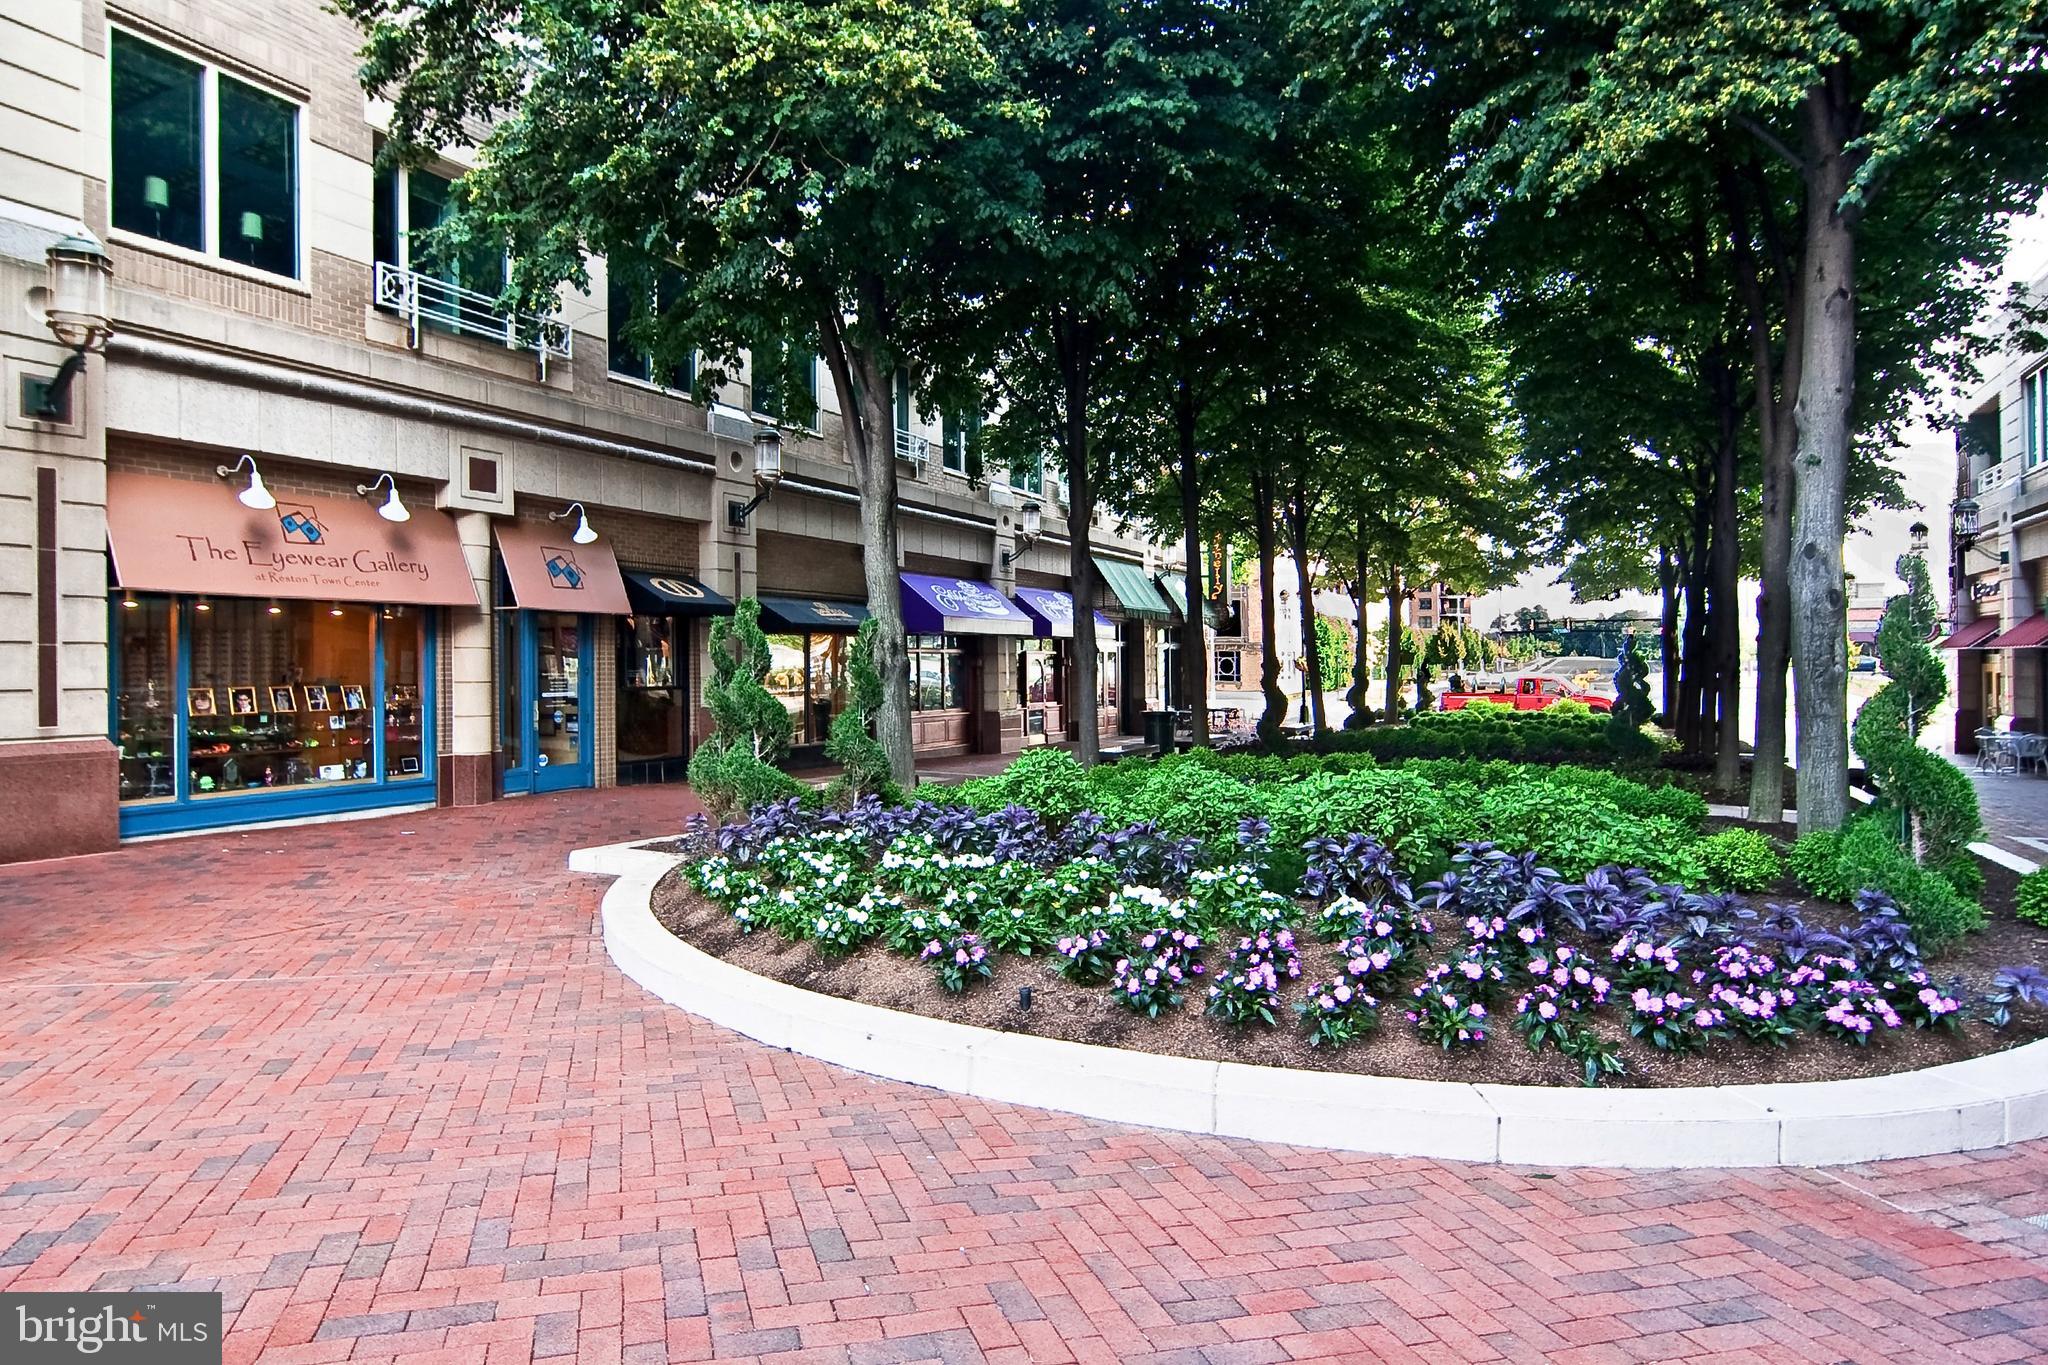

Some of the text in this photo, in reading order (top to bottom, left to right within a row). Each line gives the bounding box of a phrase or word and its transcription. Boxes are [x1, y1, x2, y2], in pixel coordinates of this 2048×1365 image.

[176, 534, 429, 581] The Eyewear Gallery
[255, 572, 381, 588] at Reston Town Center
